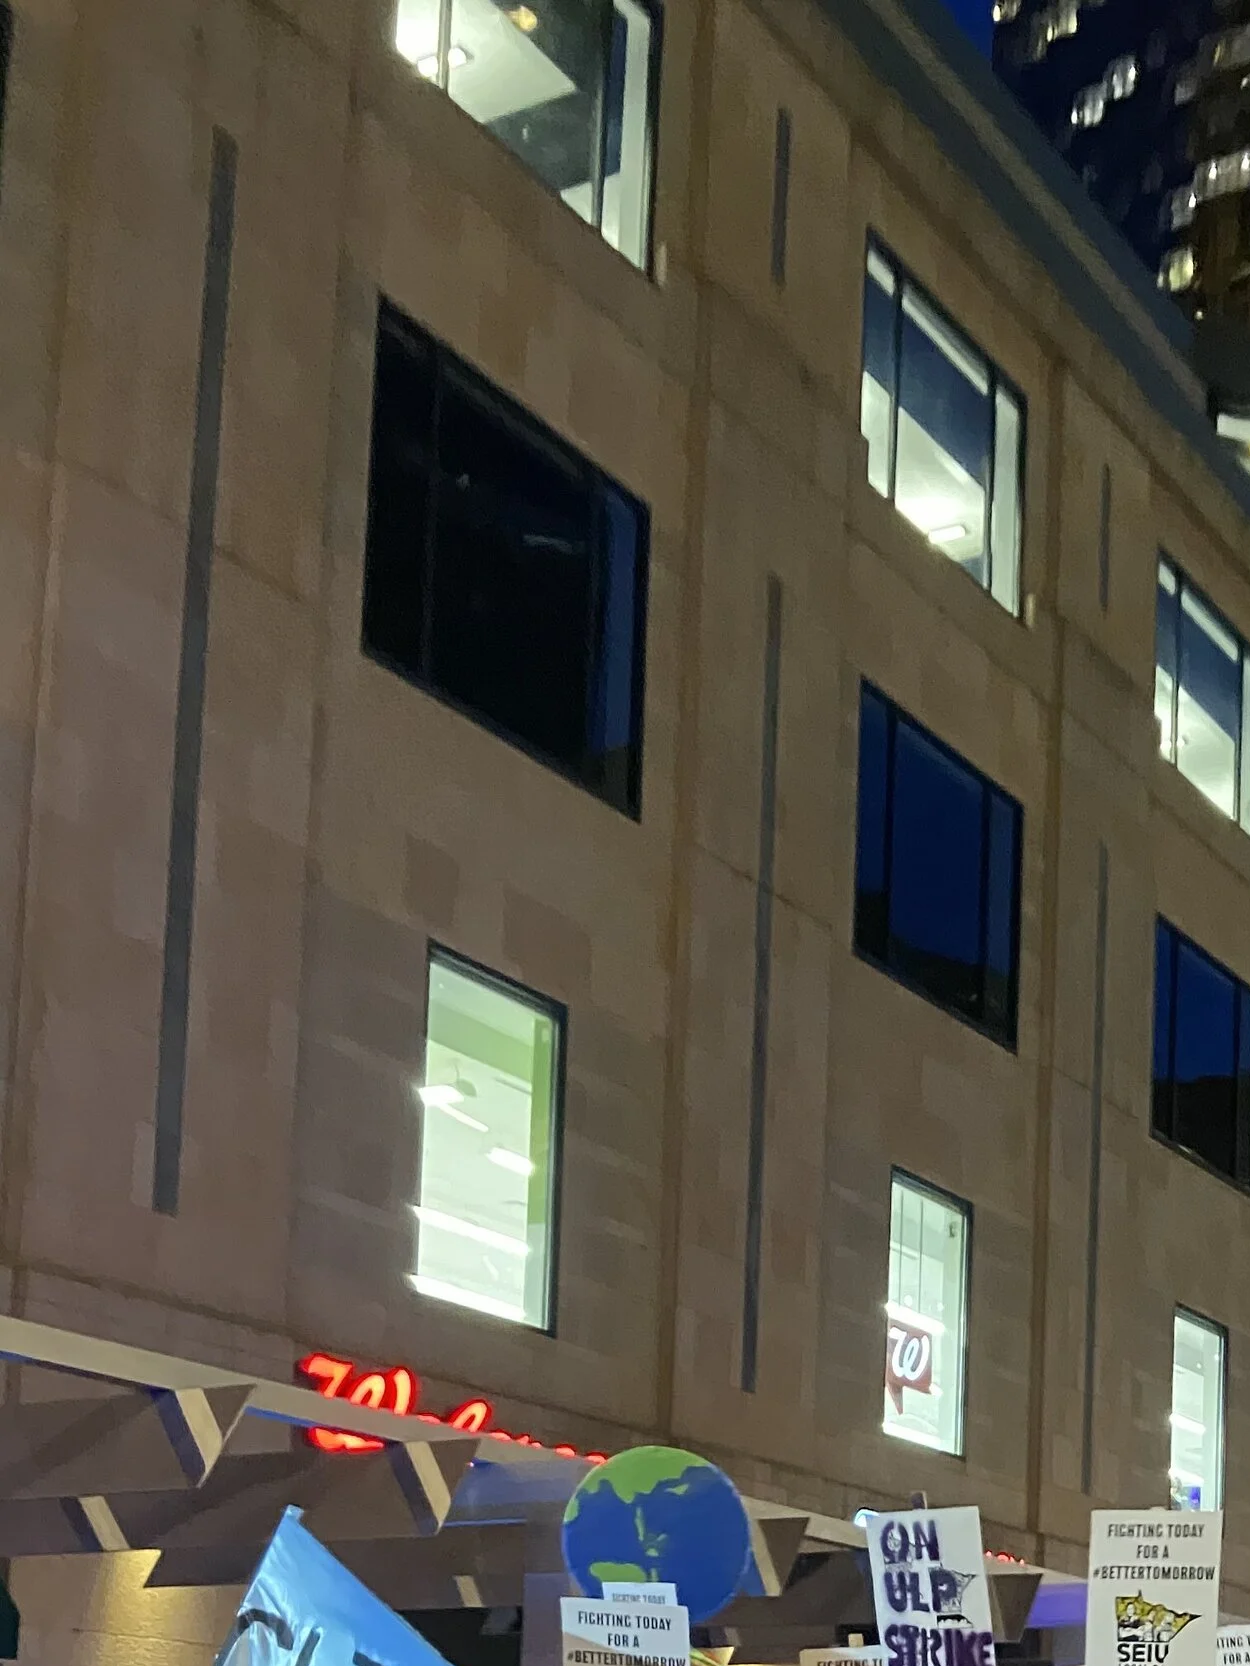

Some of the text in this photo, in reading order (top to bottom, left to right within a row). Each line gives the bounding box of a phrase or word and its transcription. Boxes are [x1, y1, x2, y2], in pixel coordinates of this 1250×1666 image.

[889, 1326, 930, 1381] W
[1108, 1524, 1204, 1538] FIGHTING TODAY
[881, 1520, 940, 1563] ON
[1136, 1545, 1169, 1558] FOR A
[1093, 1565, 1216, 1580] #BETTERTOMORROW
[884, 1569, 957, 1613] ULP
[578, 1611, 672, 1631] FIGHTING TODAY
[608, 1633, 640, 1648] FOR A
[1117, 1643, 1169, 1663] SEIU
[1223, 1652, 1250, 1665] FOR A
